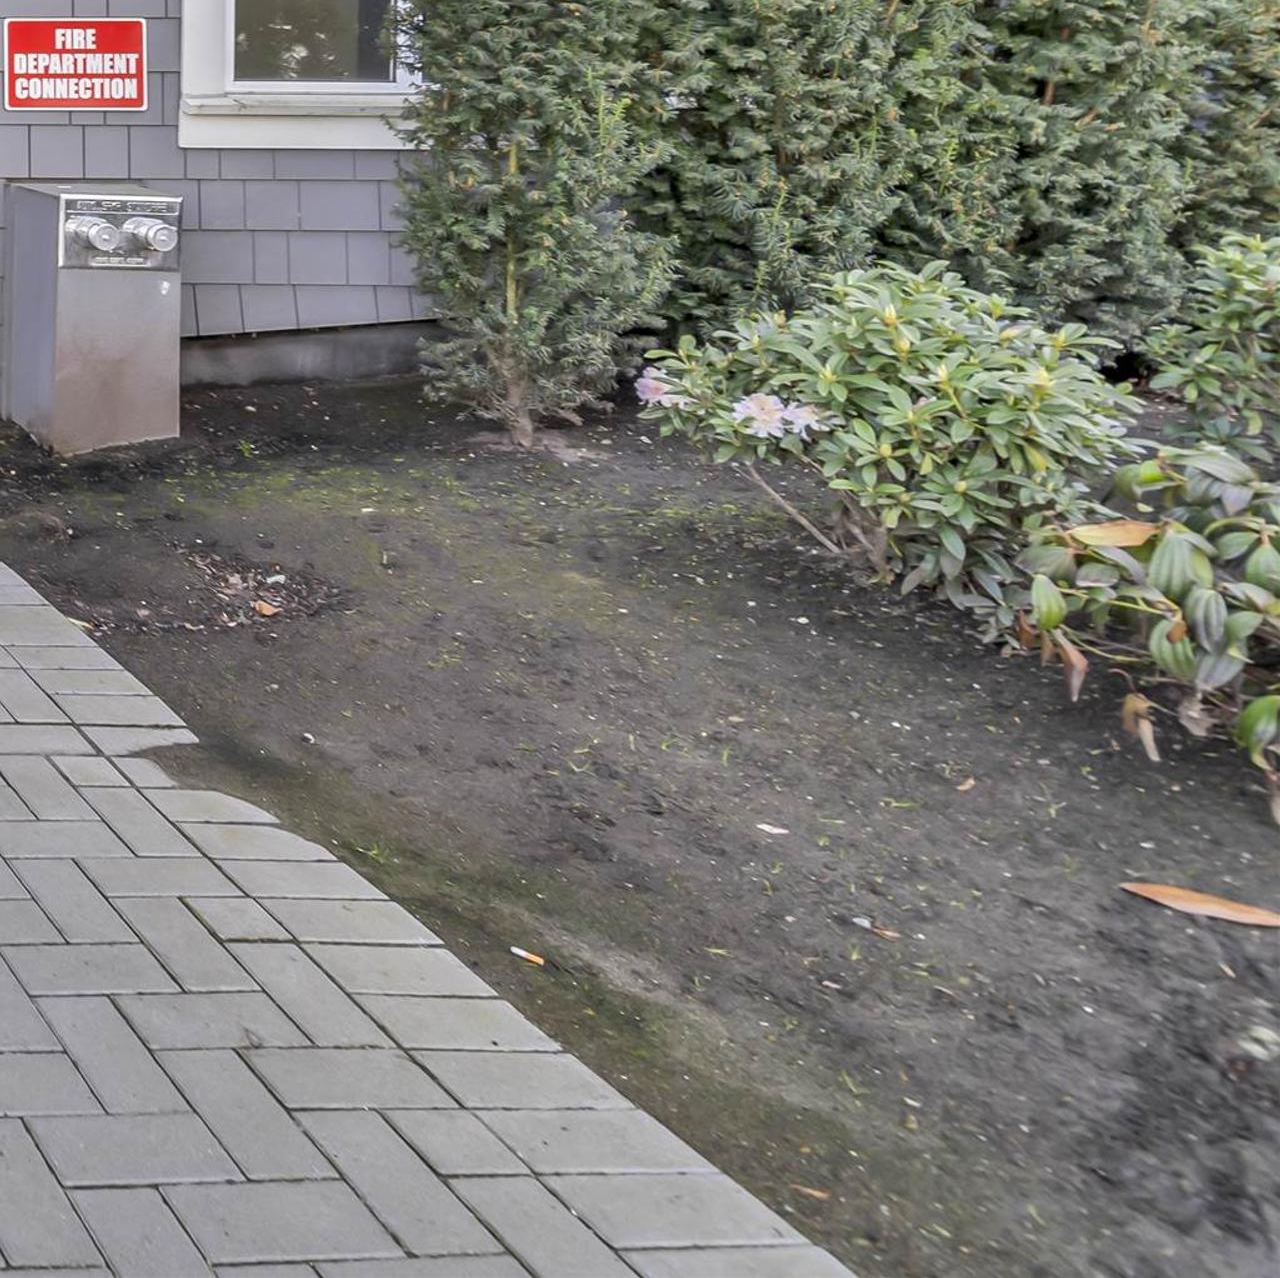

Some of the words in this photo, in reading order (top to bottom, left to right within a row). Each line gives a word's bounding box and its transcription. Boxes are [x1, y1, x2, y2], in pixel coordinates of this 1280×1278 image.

[55, 28, 96, 49] FIRE
[14, 53, 139, 74] DEPARTMENT
[15, 78, 137, 99] CONNECTION
